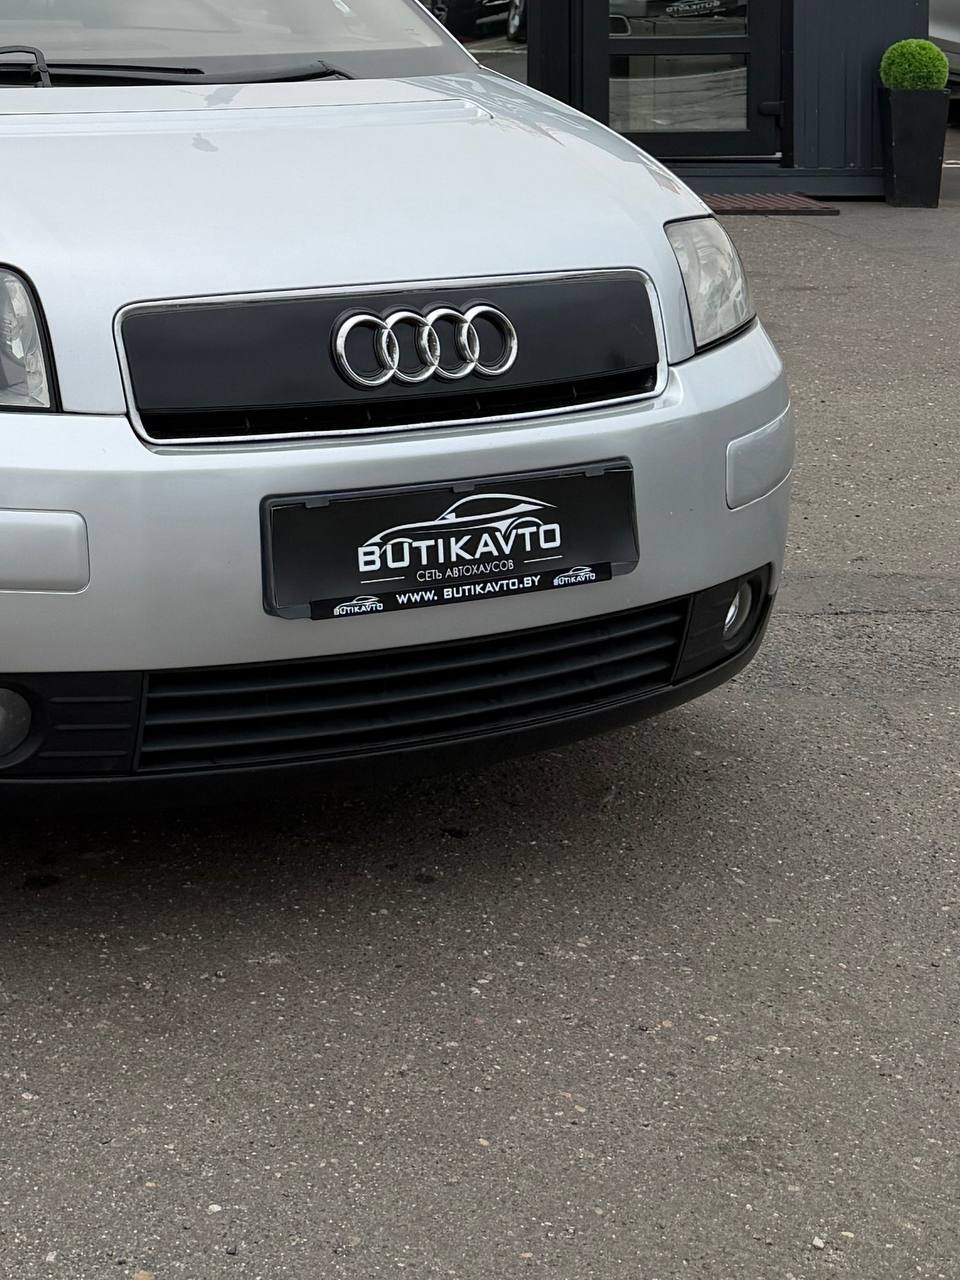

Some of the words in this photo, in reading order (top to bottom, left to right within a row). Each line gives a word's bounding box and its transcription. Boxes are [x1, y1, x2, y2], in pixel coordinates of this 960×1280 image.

[357, 523, 561, 572] BUTIKAVTO
[416, 569, 442, 581] СЕТЬ
[445, 559, 515, 579] АВТОХАУСОВ
[553, 572, 596, 586] BUTIKAVTO
[396, 590, 438, 604] WWW.
[443, 575, 541, 599] BUTIKAVTO.BY
[333, 603, 384, 615] BUTIKAVTO
